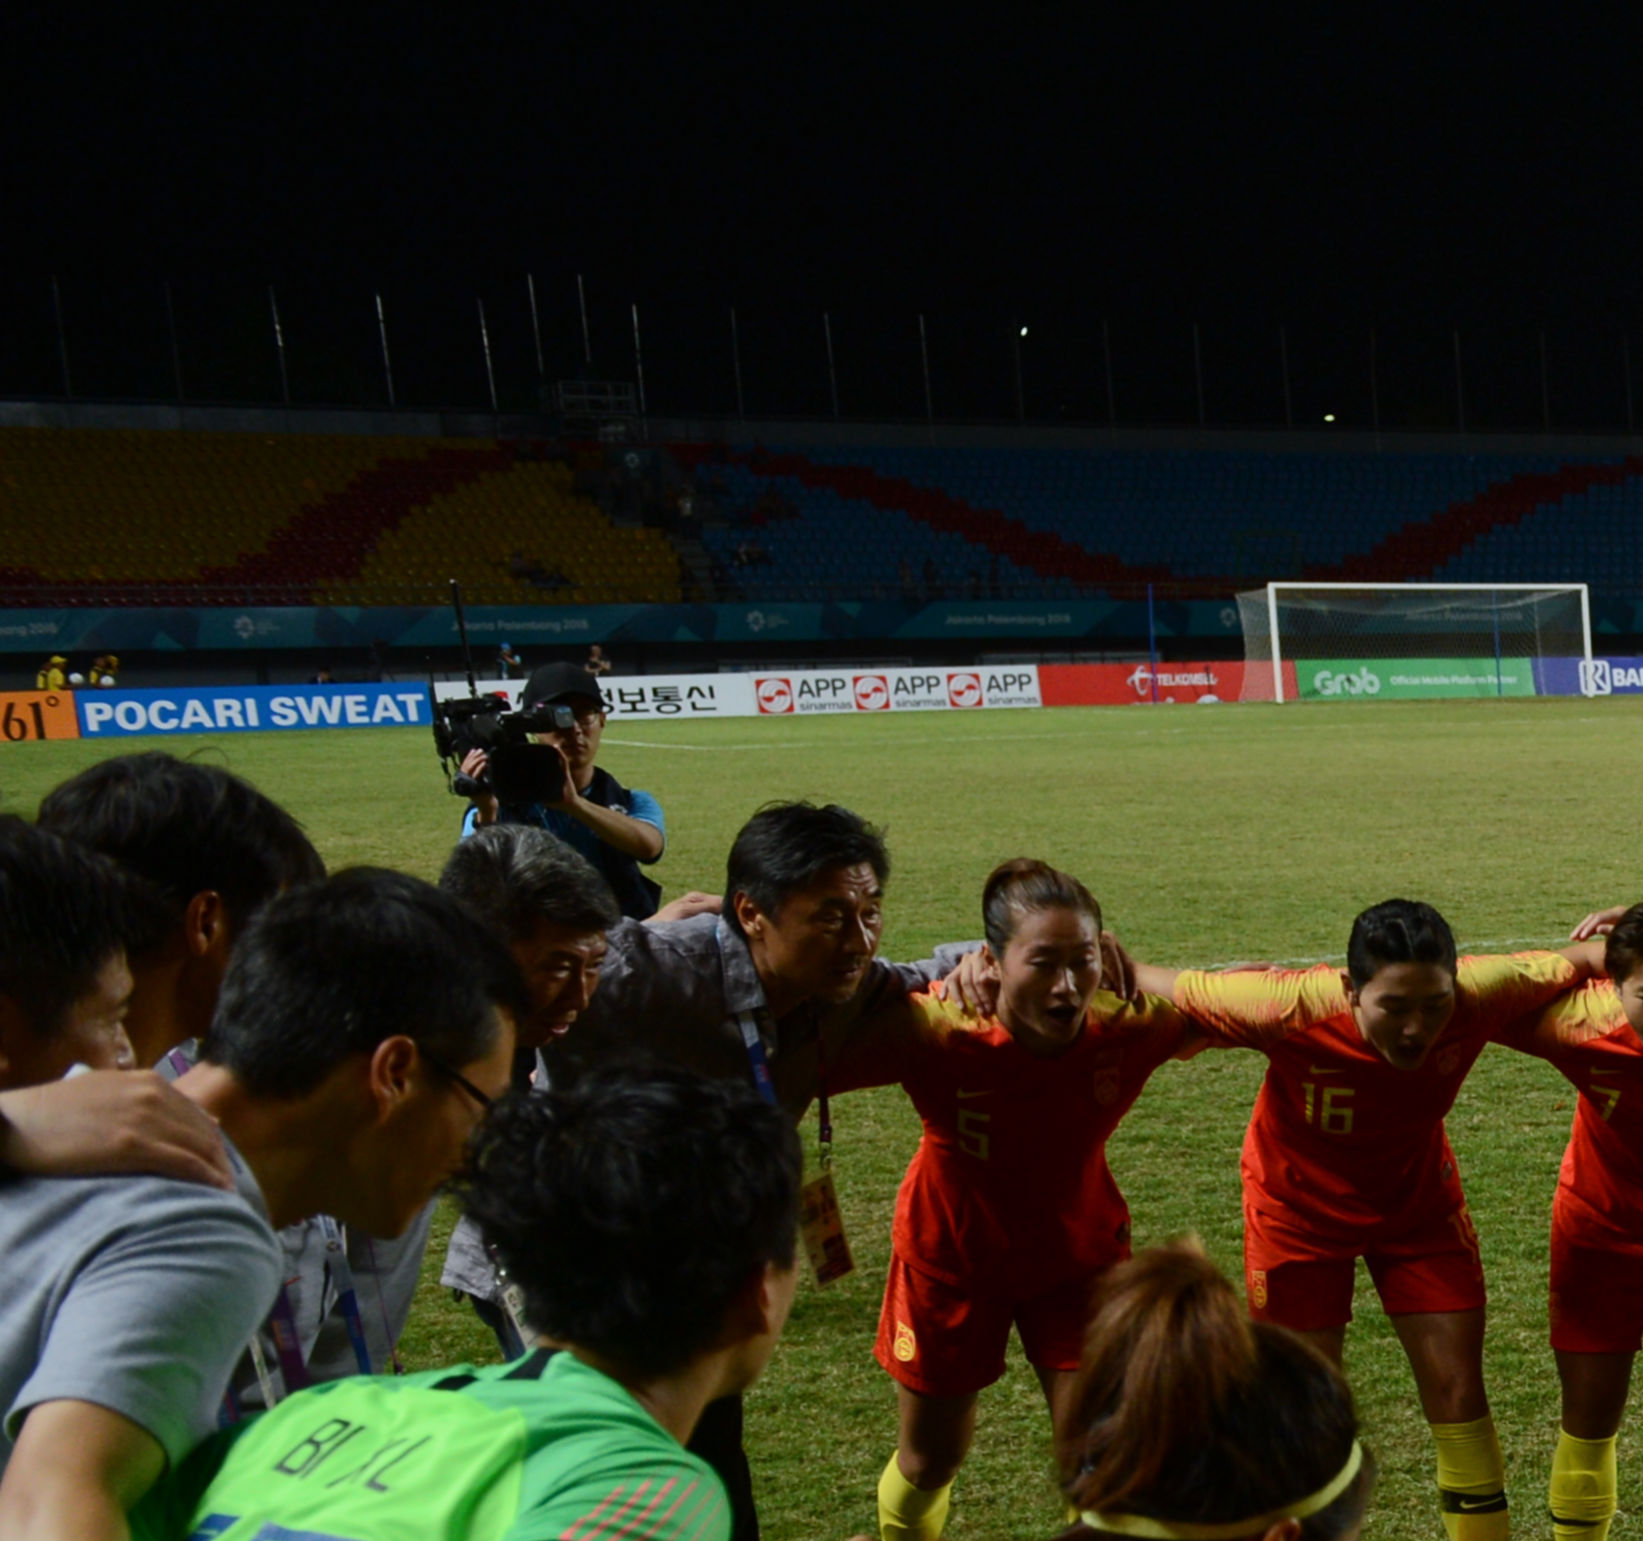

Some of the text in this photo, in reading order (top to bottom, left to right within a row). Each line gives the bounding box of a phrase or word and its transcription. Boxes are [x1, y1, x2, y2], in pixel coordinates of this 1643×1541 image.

[798, 678, 846, 698] APP
[895, 675, 941, 695] APP
[987, 673, 1032, 692] APP
[1314, 668, 1381, 695] Grab
[800, 700, 852, 711] sinarmas
[895, 697, 946, 708] sinarmas
[988, 695, 1038, 706] sinarmas
[84, 693, 424, 732] POCARI SWEAT
[1301, 1082, 1355, 1134] 16
[958, 1108, 991, 1162] 5
[275, 1418, 366, 1478] BI
